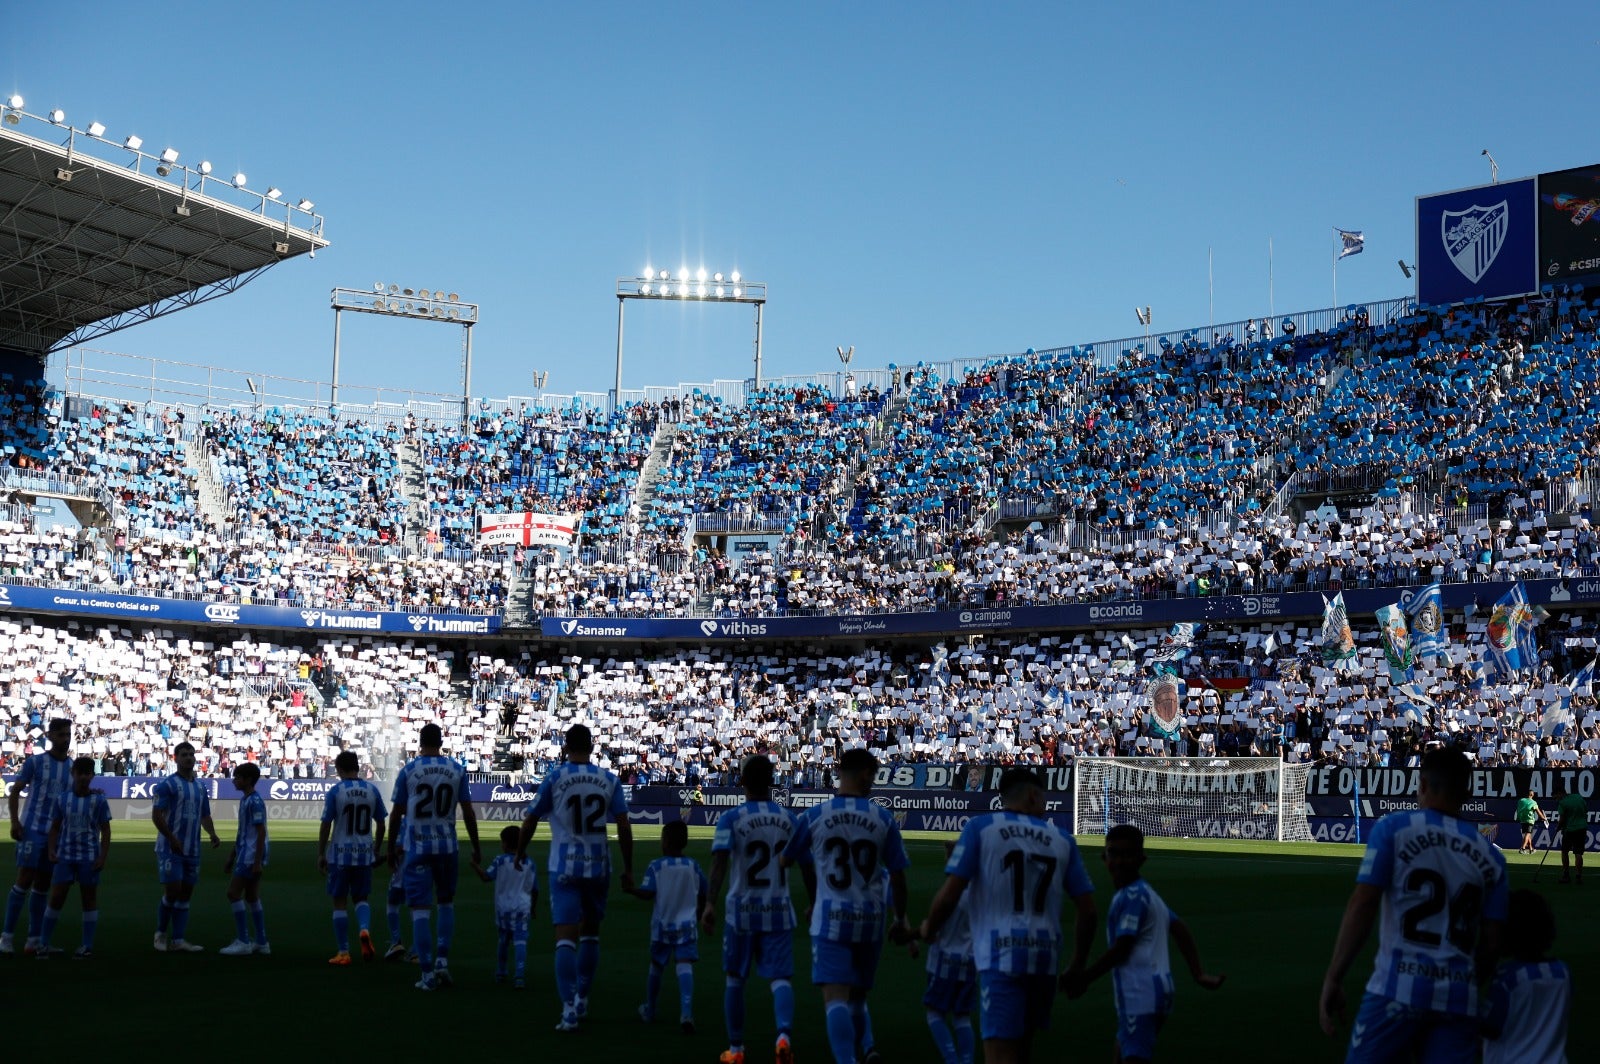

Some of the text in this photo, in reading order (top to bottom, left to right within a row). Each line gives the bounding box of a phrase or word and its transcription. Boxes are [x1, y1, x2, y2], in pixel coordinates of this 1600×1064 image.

[488, 532, 566, 541] GUIRI ARMY
[53, 596, 160, 612] Cesur, tu Centro Oficial de FP
[1099, 602, 1143, 618] coanda
[321, 614, 381, 629] hummel
[974, 610, 1012, 623] campano
[428, 618, 488, 633] hummel
[576, 625, 626, 636] Sanamar
[721, 621, 767, 636] vithas
[291, 782, 324, 792] COSTA
[1306, 768, 1330, 795] TE
[291, 791, 326, 801] MÁLAG
[415, 783, 454, 818] 20
[893, 796, 970, 810] Garum Motor
[567, 794, 606, 834] 12
[1379, 800, 1487, 813] Diputac ncial
[342, 803, 371, 836] 10
[824, 812, 877, 833] CRISTIAN
[921, 815, 971, 831] VAMO
[746, 839, 789, 888] 21
[1002, 849, 1058, 913] 17
[1403, 868, 1482, 951] 24
